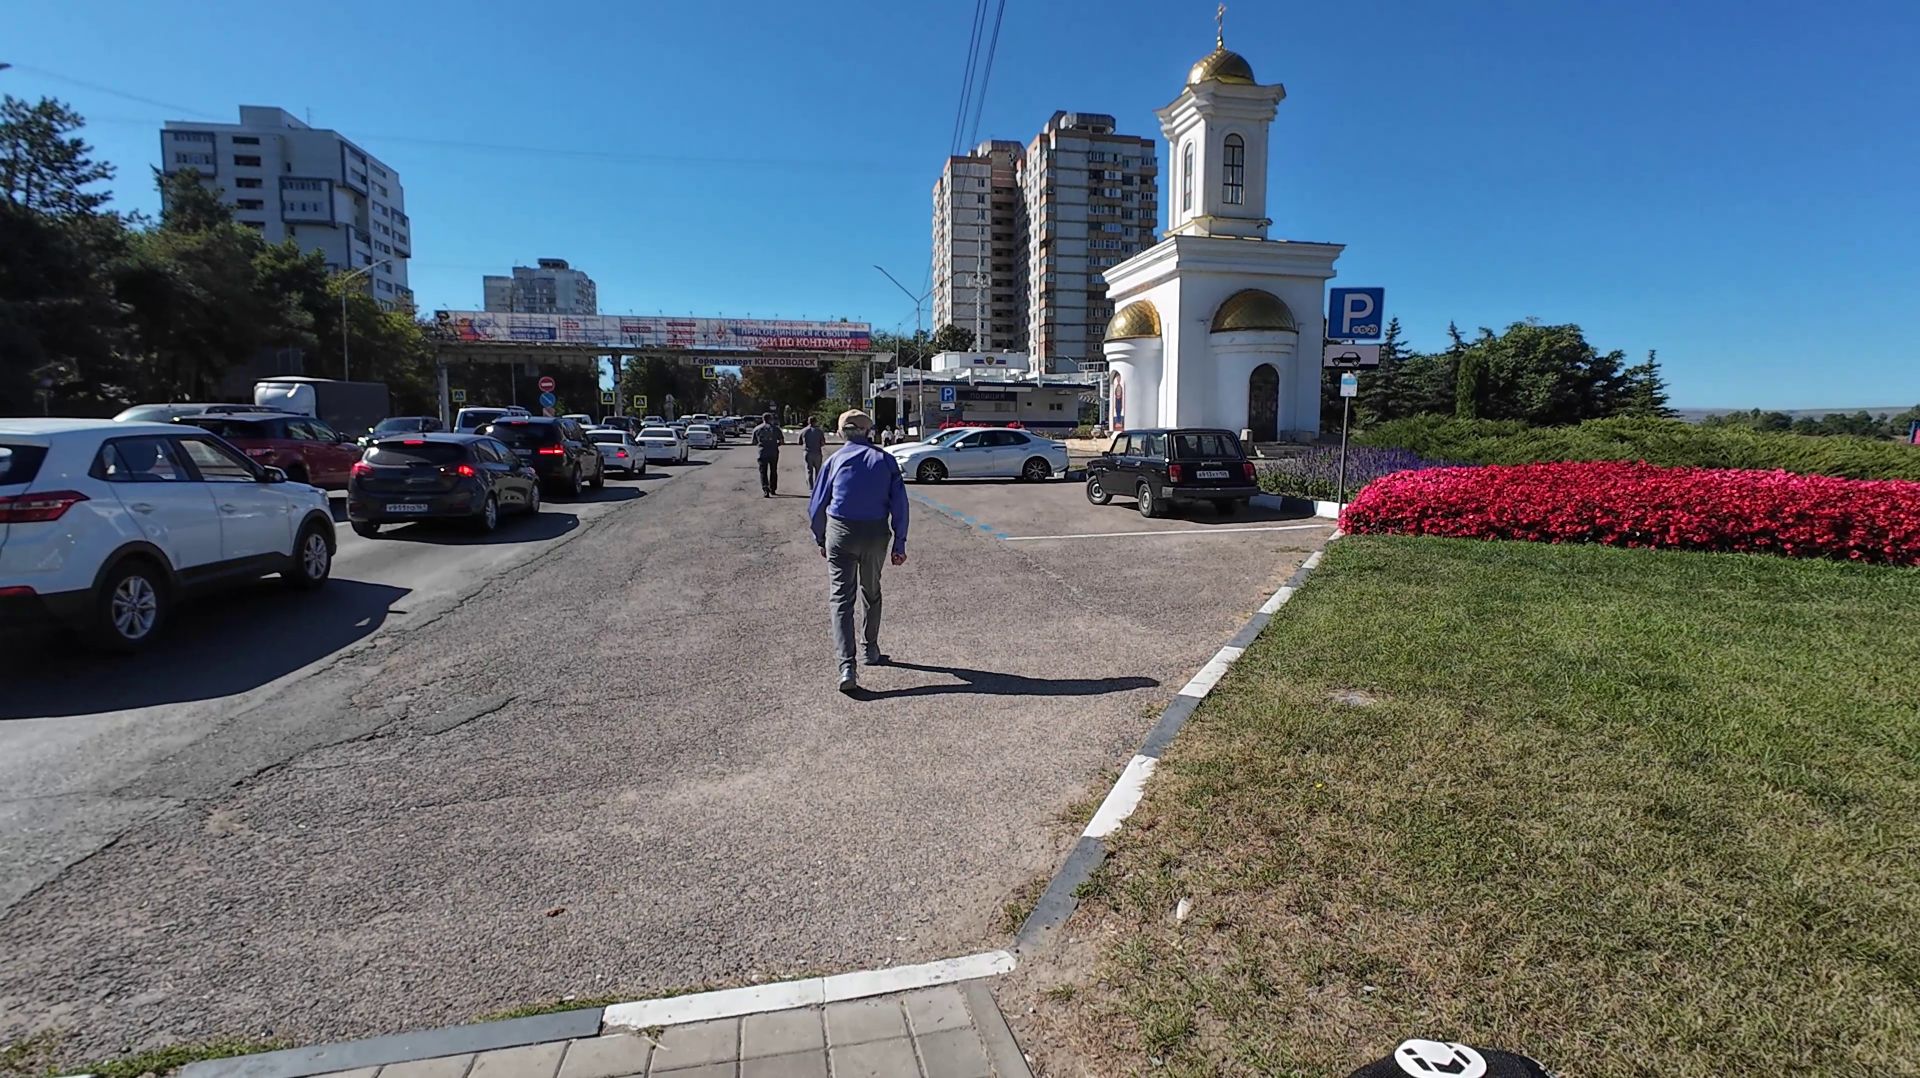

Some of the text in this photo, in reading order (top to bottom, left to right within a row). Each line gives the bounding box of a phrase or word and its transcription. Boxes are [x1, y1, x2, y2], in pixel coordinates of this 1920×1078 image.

[1342, 293, 1374, 333] P
[780, 337, 794, 347] ПО
[799, 337, 851, 348] КОНТРАКТУ
[693, 357, 816, 367] Город-курорт КИСЛОВОДСК
